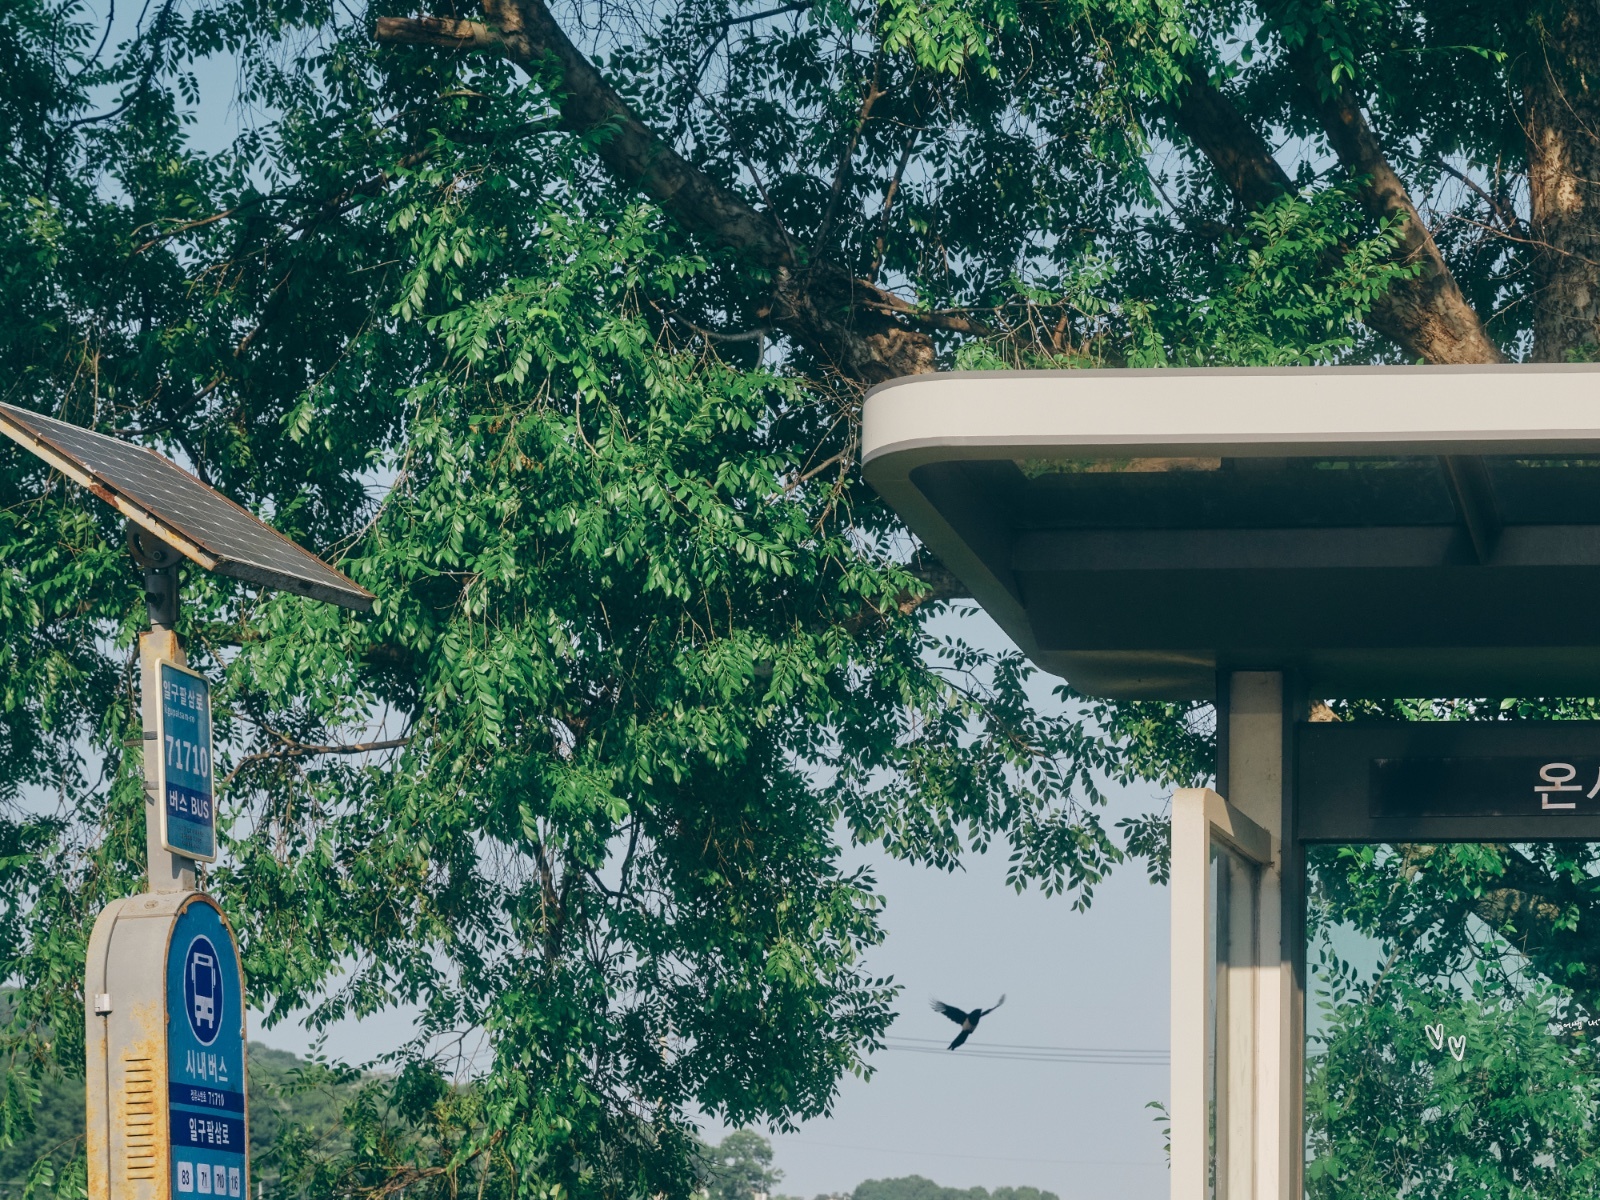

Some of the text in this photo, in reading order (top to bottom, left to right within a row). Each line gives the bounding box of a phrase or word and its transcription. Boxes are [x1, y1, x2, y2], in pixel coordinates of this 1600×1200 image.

[163, 680, 203, 711] 일구팔삼로
[166, 734, 207, 777] 71710
[169, 790, 210, 819] 버스 BUS
[186, 1050, 228, 1083] 시내버스
[207, 1091, 224, 1107] 71710
[189, 1117, 230, 1145] 일구팔삼로
[181, 1169, 189, 1186] 83
[201, 1171, 207, 1188] 71
